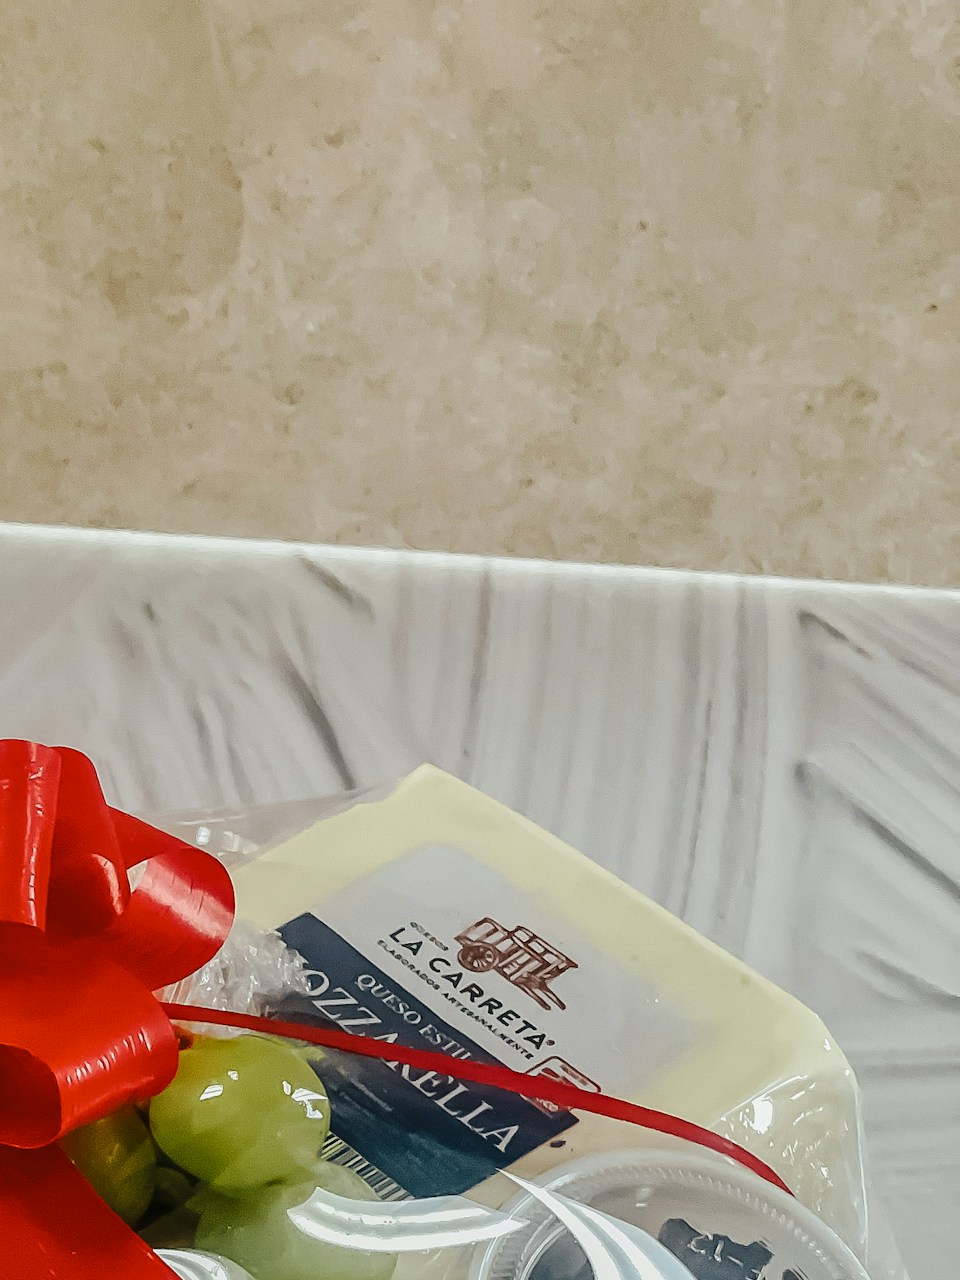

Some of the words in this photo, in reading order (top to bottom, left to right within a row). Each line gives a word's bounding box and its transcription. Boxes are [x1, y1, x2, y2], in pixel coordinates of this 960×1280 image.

[355, 972, 424, 1026] QUESO
[376, 938, 441, 991] ELABORADOS
[440, 990, 535, 1061] ARTESANALMENTE
[389, 925, 421, 957] LA
[428, 956, 550, 1051] CARRETA
